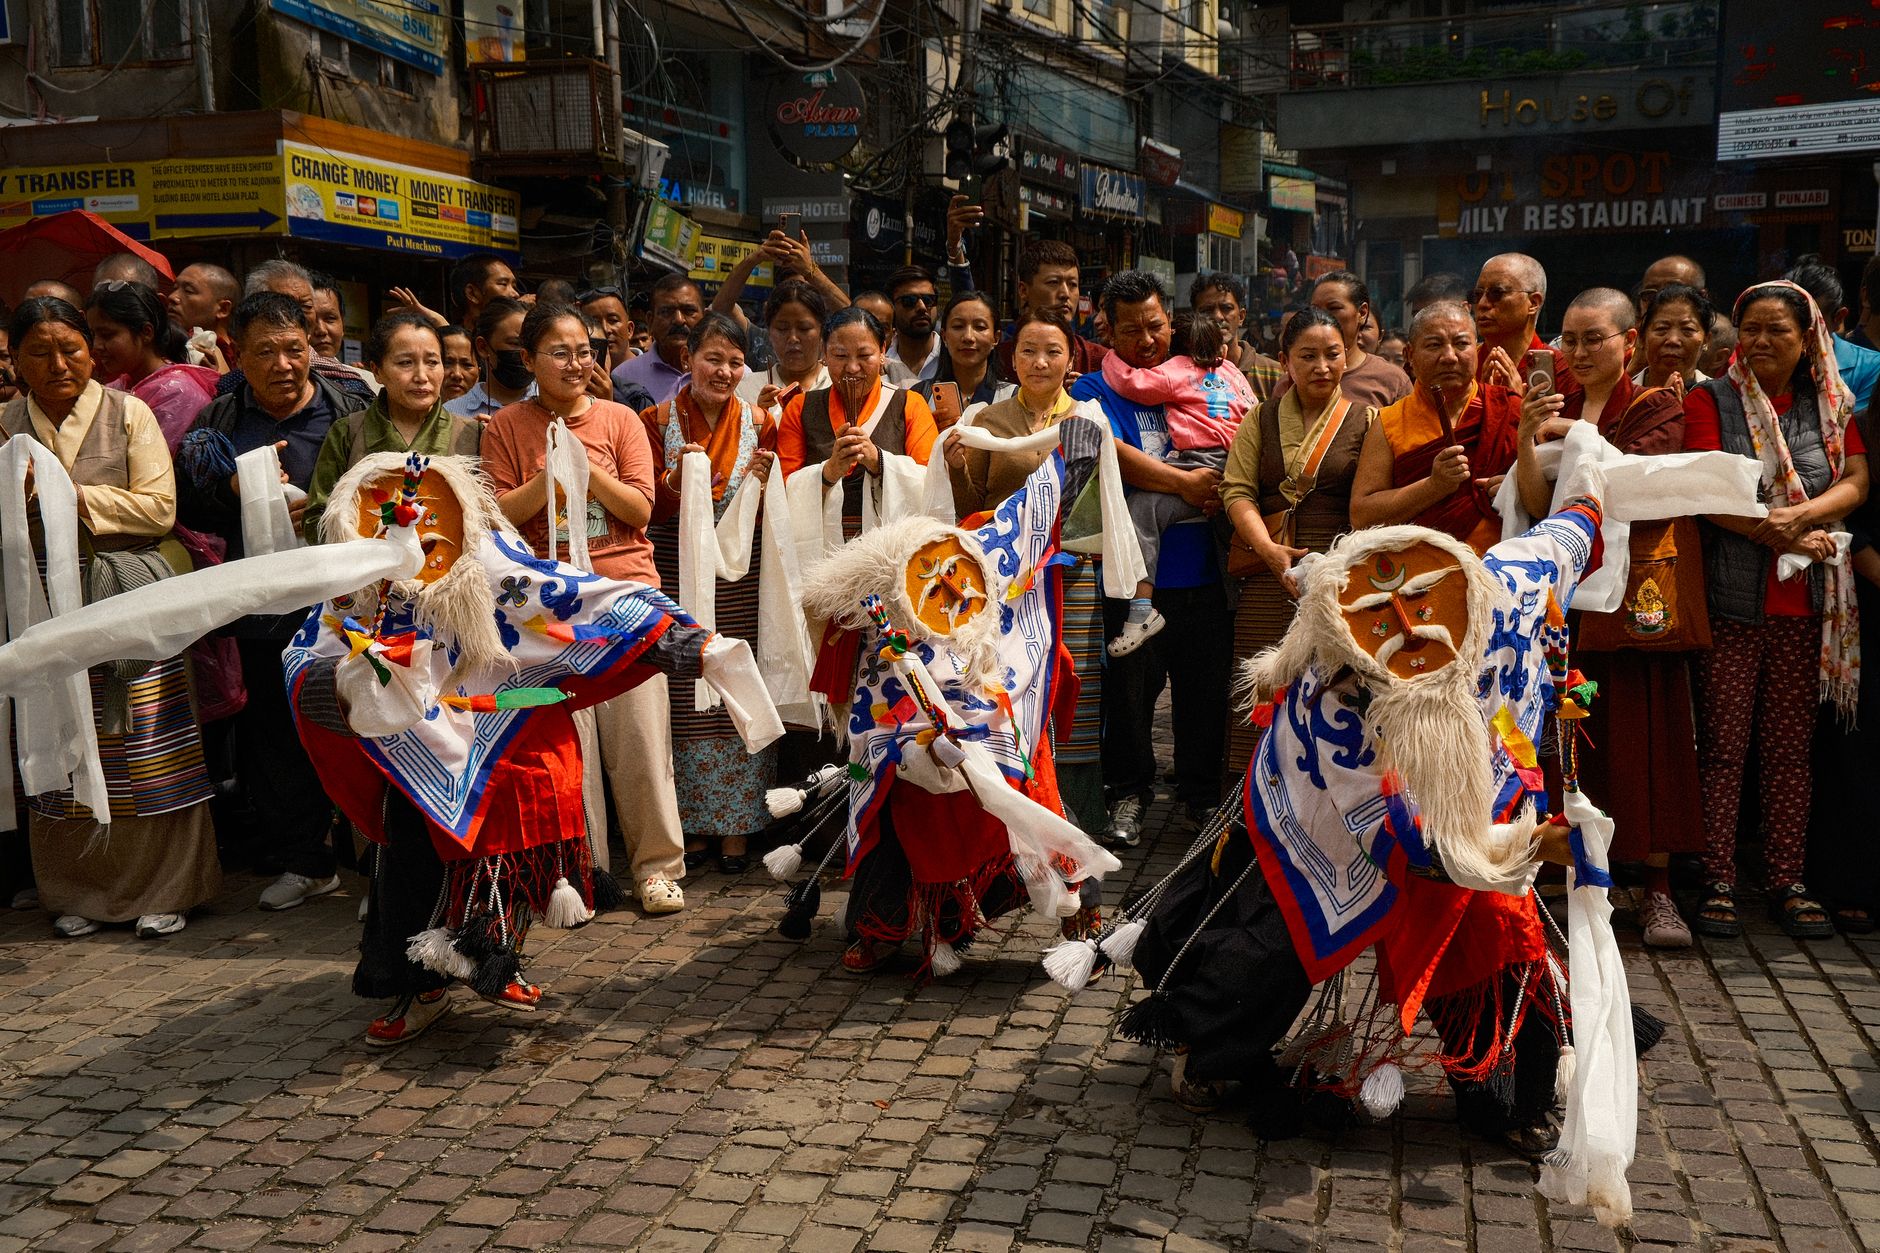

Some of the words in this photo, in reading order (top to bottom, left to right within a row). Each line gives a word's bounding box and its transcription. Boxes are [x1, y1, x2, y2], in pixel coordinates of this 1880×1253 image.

[403, 14, 433, 41] BSNL
[777, 88, 861, 125] Asian
[1479, 88, 1617, 127] House
[1635, 76, 1696, 118] Of
[804, 123, 858, 137] PLAZA
[152, 166, 162, 176] THE
[163, 165, 183, 175] OFFICE
[214, 163, 230, 173] HAVE
[232, 162, 248, 173] BEEN
[249, 161, 273, 172] SHIFTED
[1541, 150, 1672, 199] SPOT
[15, 168, 136, 193] TRANSFER
[153, 179, 198, 190] APPROXIMATELY
[207, 178, 228, 188] METER
[229, 178, 237, 187] TO
[238, 177, 249, 187] THE
[292, 155, 349, 186] CHANGE
[353, 168, 399, 195] MONEY
[410, 180, 453, 205] MONEY
[457, 188, 516, 217] TRANSFER
[153, 193, 178, 203] BUILDING
[180, 192, 200, 202] BELOW
[201, 192, 221, 201] HOTEL
[222, 191, 240, 201] ASIAN
[240, 191, 259, 200] PLAZA
[340, 199, 353, 207] VISA
[687, 186, 728, 209] HOTEL
[1718, 194, 1763, 208] CHINESE
[1778, 191, 1826, 204] PUNJABI
[802, 202, 846, 217] HOTEL
[1524, 197, 1708, 231] RESTAURANT
[721, 244, 742, 258] MONEY
